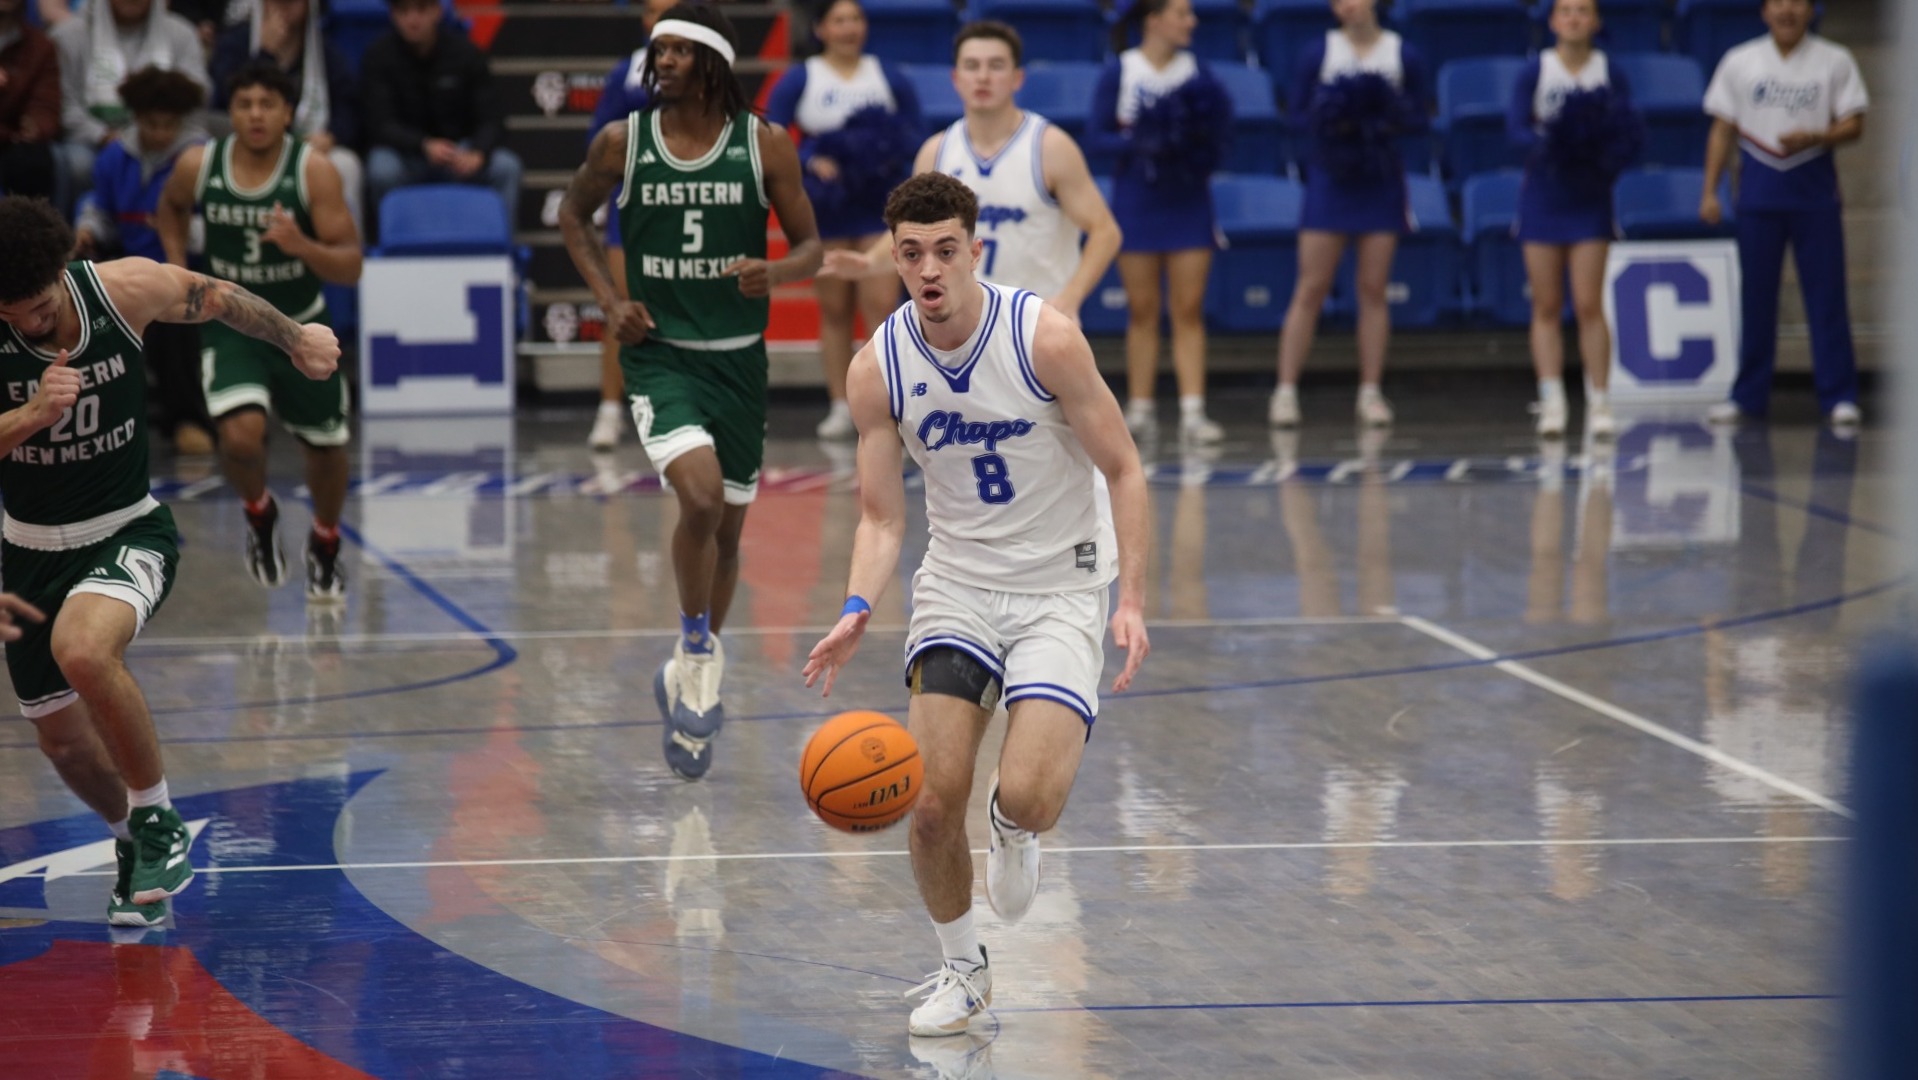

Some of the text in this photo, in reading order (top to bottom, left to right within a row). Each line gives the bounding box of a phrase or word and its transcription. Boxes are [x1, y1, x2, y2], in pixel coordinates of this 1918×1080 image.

[206, 201, 295, 229] EASTE
[641, 182, 743, 205] EASTERN
[242, 228, 261, 264] 3
[682, 209, 703, 253] 5
[642, 253, 674, 280] NEW
[1613, 257, 1716, 384] C
[7, 353, 126, 402] EAERN
[50, 394, 100, 442] 20
[917, 410, 1037, 452] Chaps
[11, 417, 136, 465] NEW MEXICO
[971, 452, 1016, 505] 8
